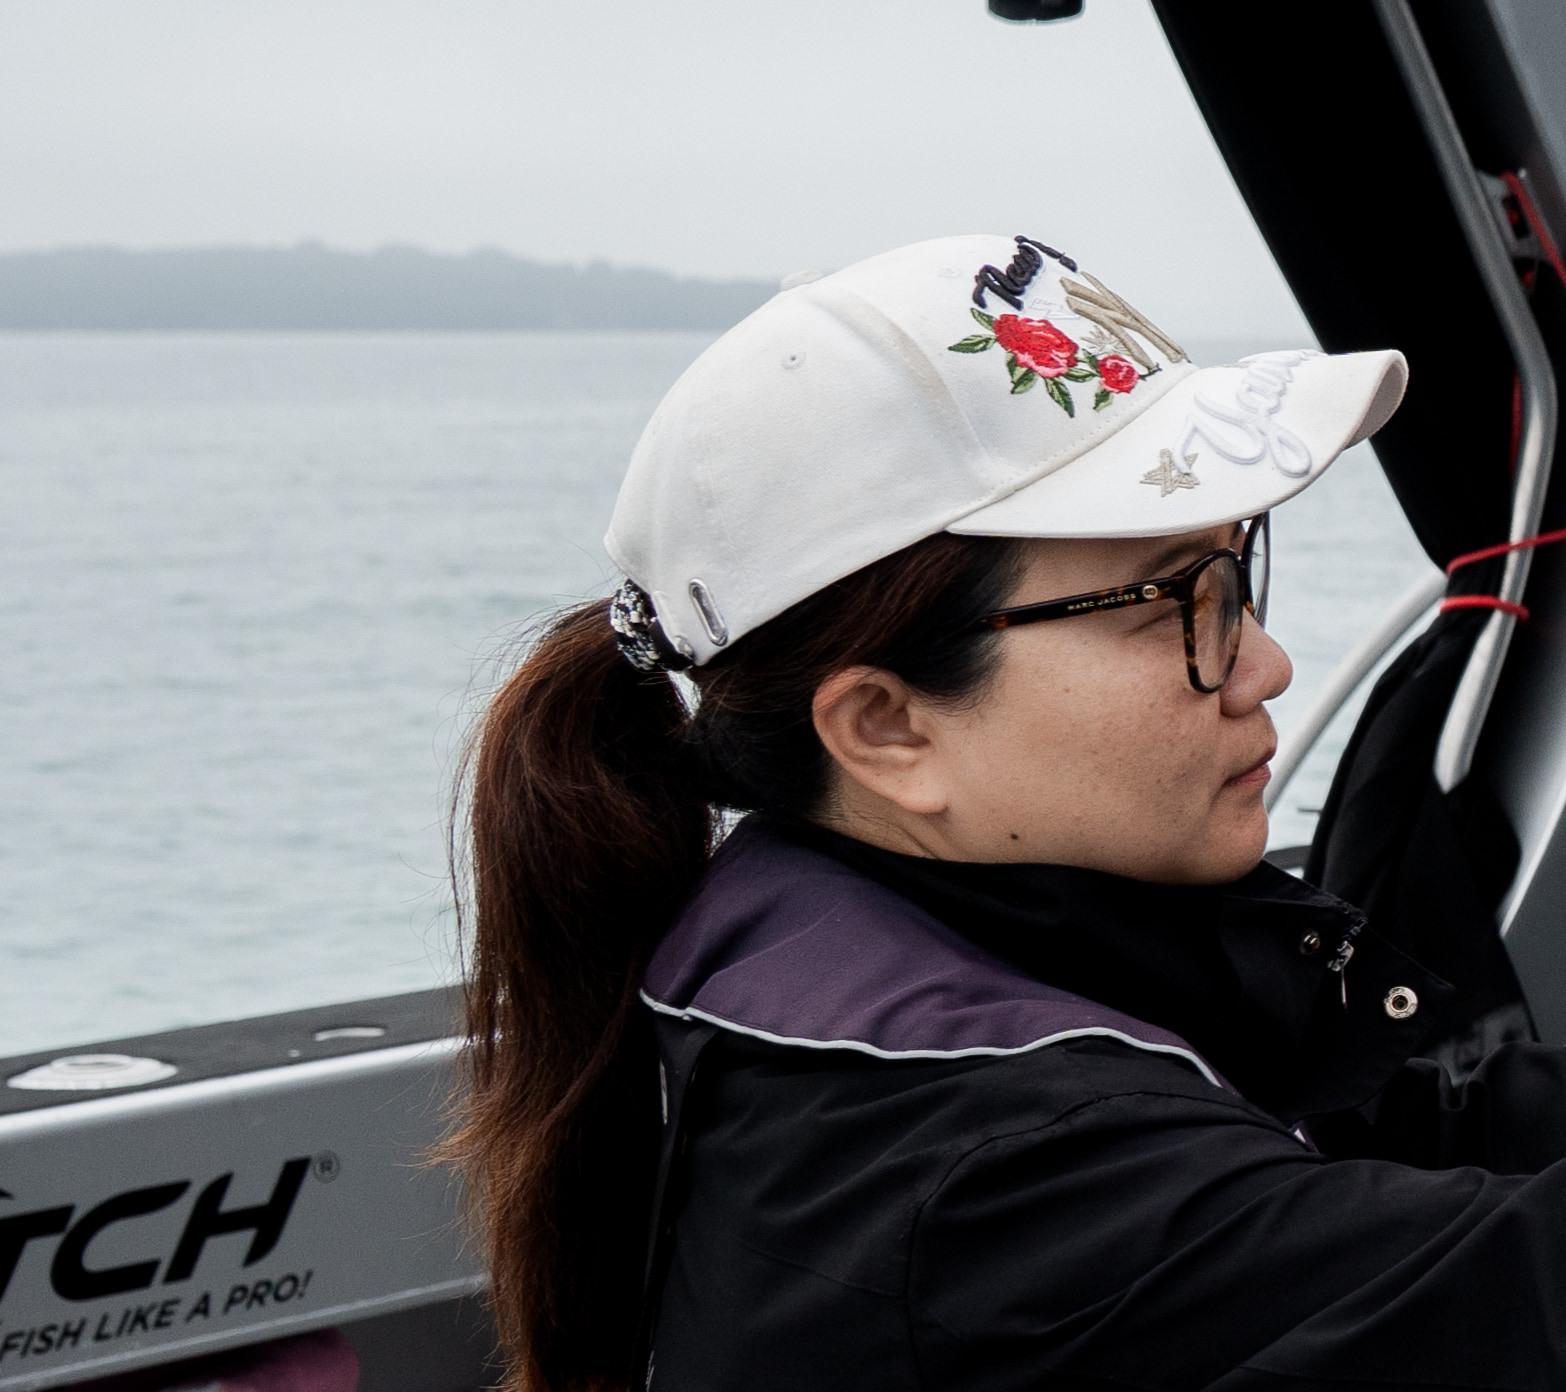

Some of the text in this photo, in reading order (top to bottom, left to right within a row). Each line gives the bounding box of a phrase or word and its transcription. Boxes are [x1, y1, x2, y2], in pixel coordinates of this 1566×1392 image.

[1067, 593, 1137, 611] MARC JACOBS
[0, 1269, 313, 1358] FISH LIKE A PRO!
